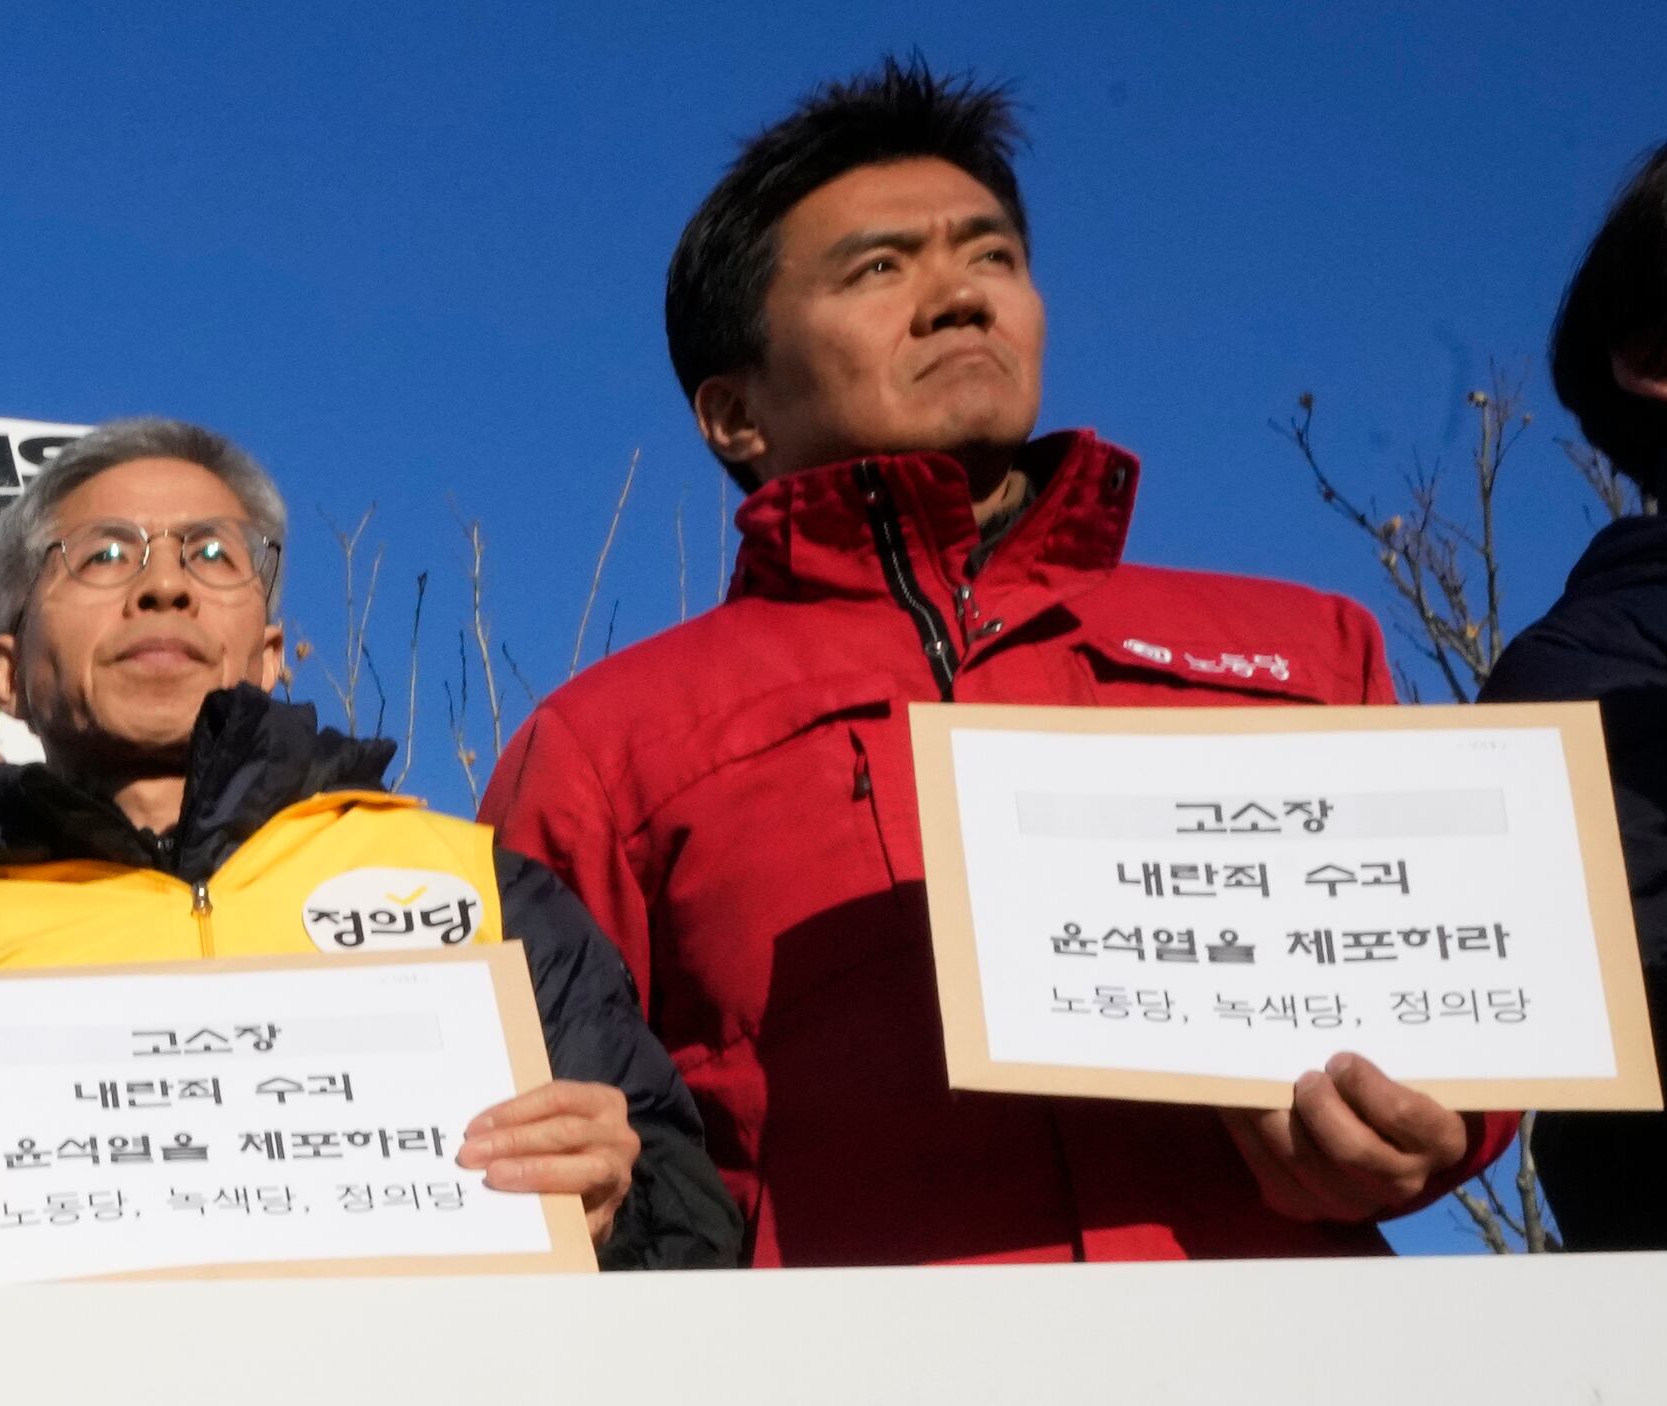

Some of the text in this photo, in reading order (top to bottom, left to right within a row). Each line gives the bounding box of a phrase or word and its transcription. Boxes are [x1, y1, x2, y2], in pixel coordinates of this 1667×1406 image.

[1175, 797, 1335, 834] 고소장
[1116, 859, 1411, 898] 내란죄 수괴
[308, 897, 477, 947] 정의당
[1050, 921, 1511, 965] 윤석열을 체포하라
[1050, 985, 1533, 1029] 노동당, 녹색당, 정의당
[132, 1022, 282, 1058] 고소장
[73, 1072, 354, 1110] 내란죄 수괴
[3, 1126, 447, 1169] 윤석열을 체포하라
[0, 1181, 468, 1229] 노동당, 녹색당, 정의당
